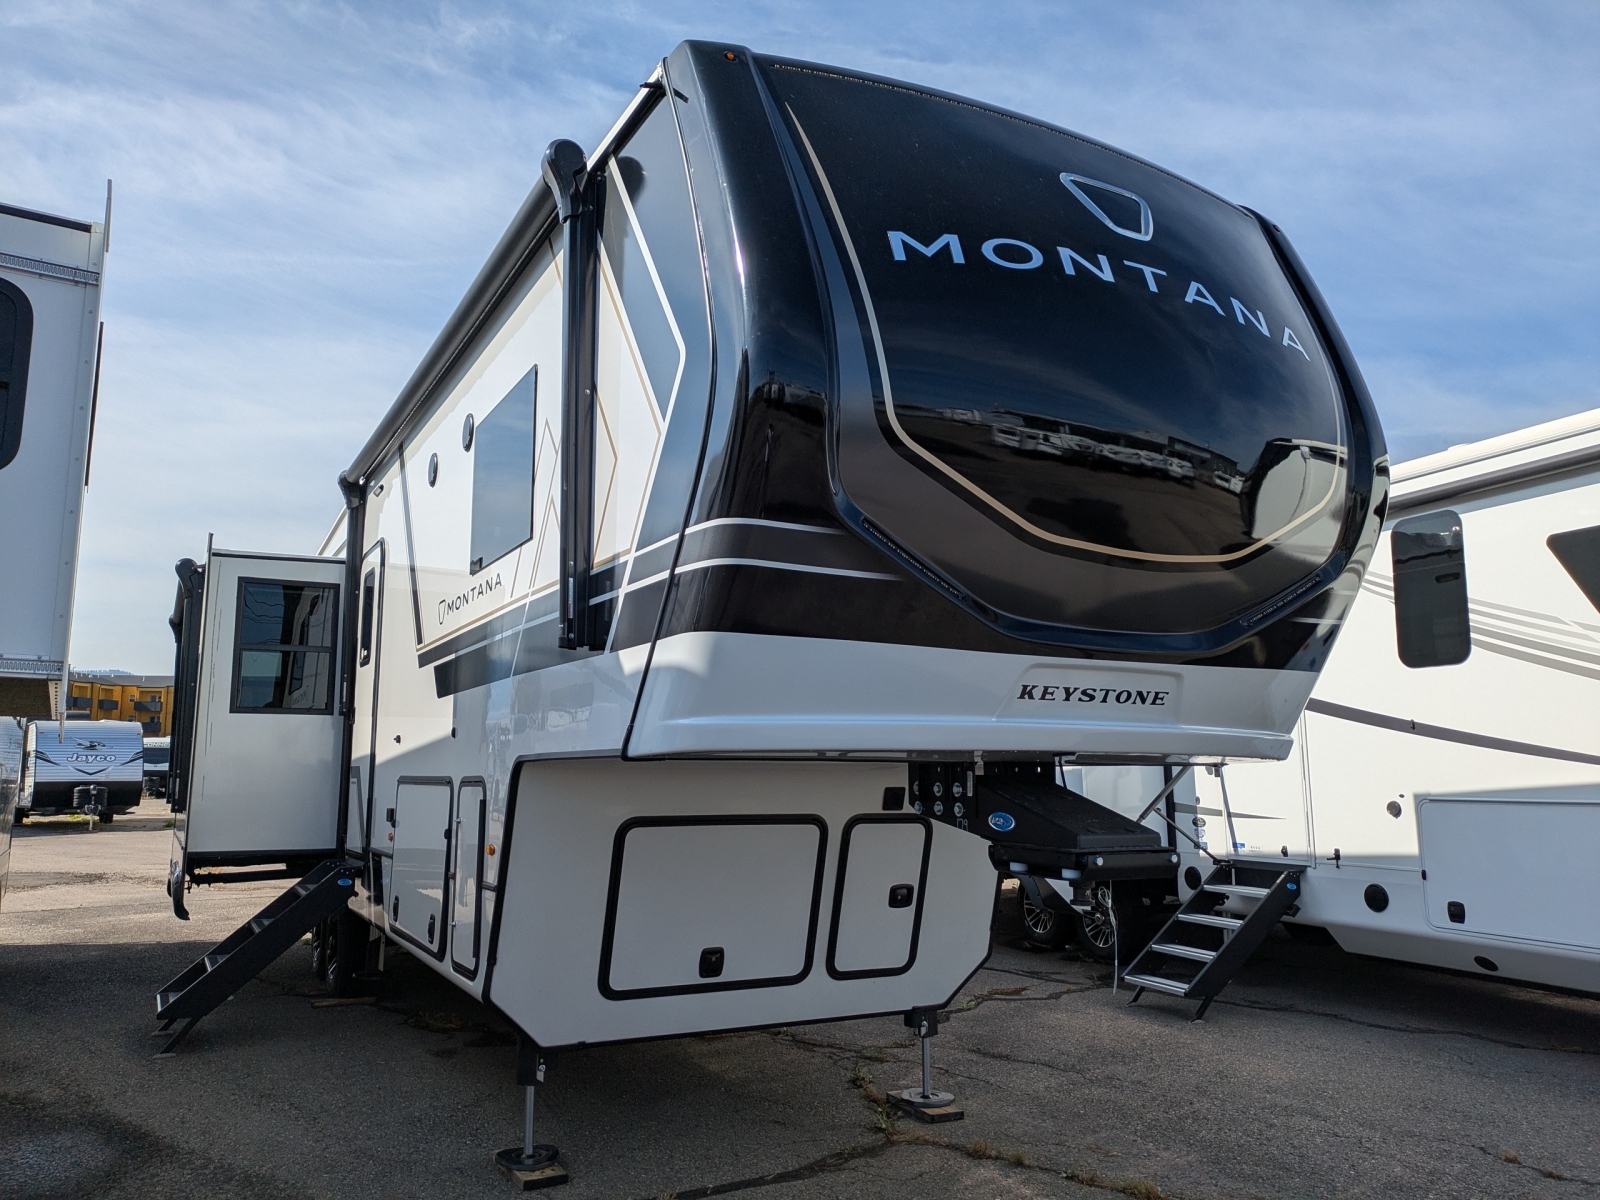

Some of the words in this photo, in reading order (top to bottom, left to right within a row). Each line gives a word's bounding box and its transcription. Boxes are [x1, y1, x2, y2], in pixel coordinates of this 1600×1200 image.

[887, 230, 1311, 362] MONTANA
[446, 572, 502, 616] MONTANA
[1017, 684, 1170, 706] KEYSTONE
[67, 752, 117, 764] Jayco
